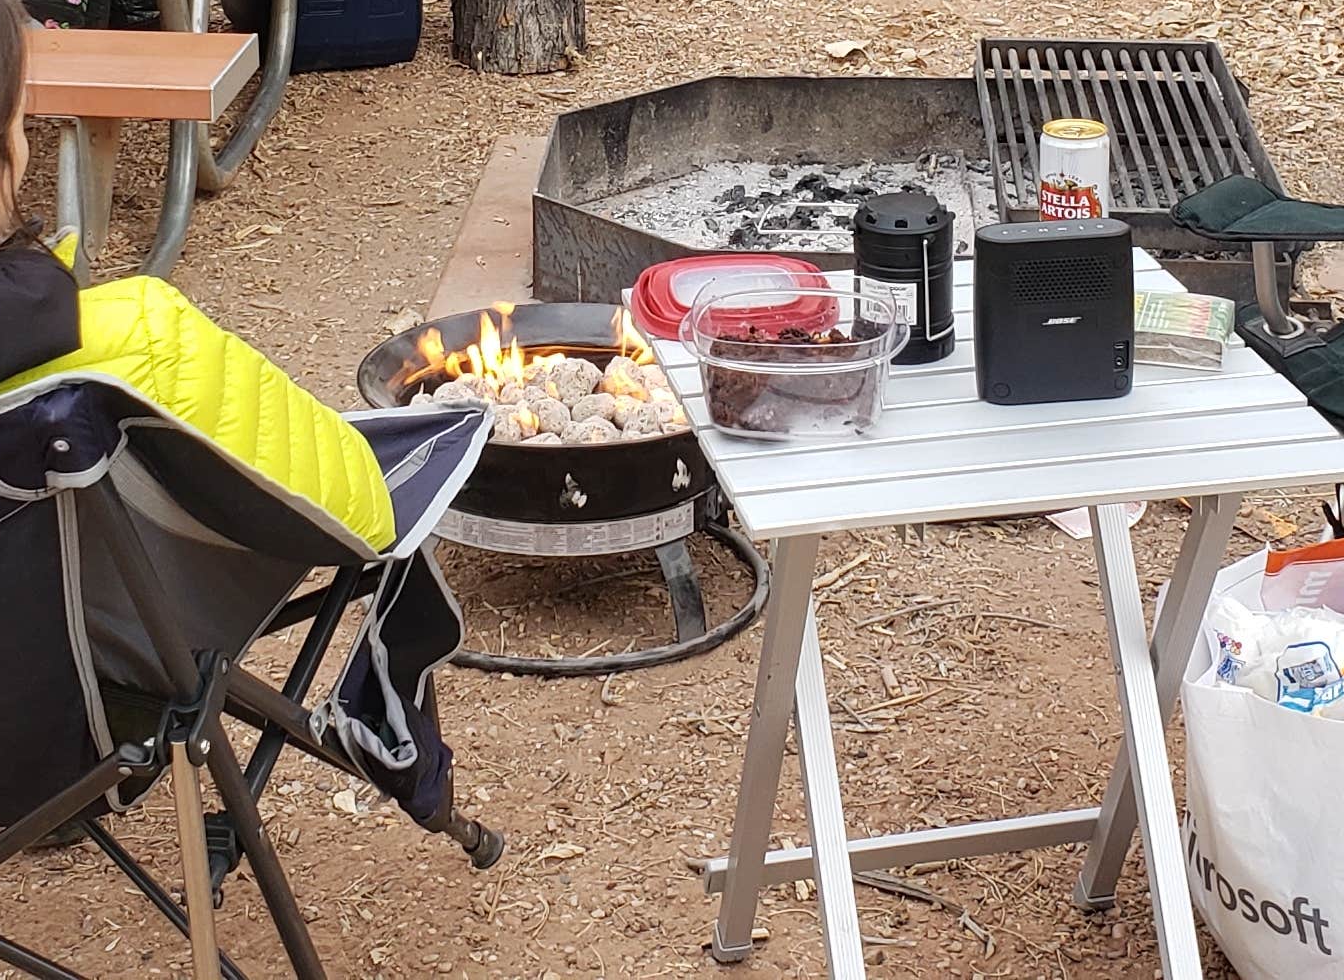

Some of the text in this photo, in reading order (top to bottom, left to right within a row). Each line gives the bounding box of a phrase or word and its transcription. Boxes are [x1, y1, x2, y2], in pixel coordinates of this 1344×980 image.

[1041, 189, 1091, 207] STELLA
[1041, 202, 1091, 219] ARTOIS
[1185, 809, 1332, 956] icrosoft
